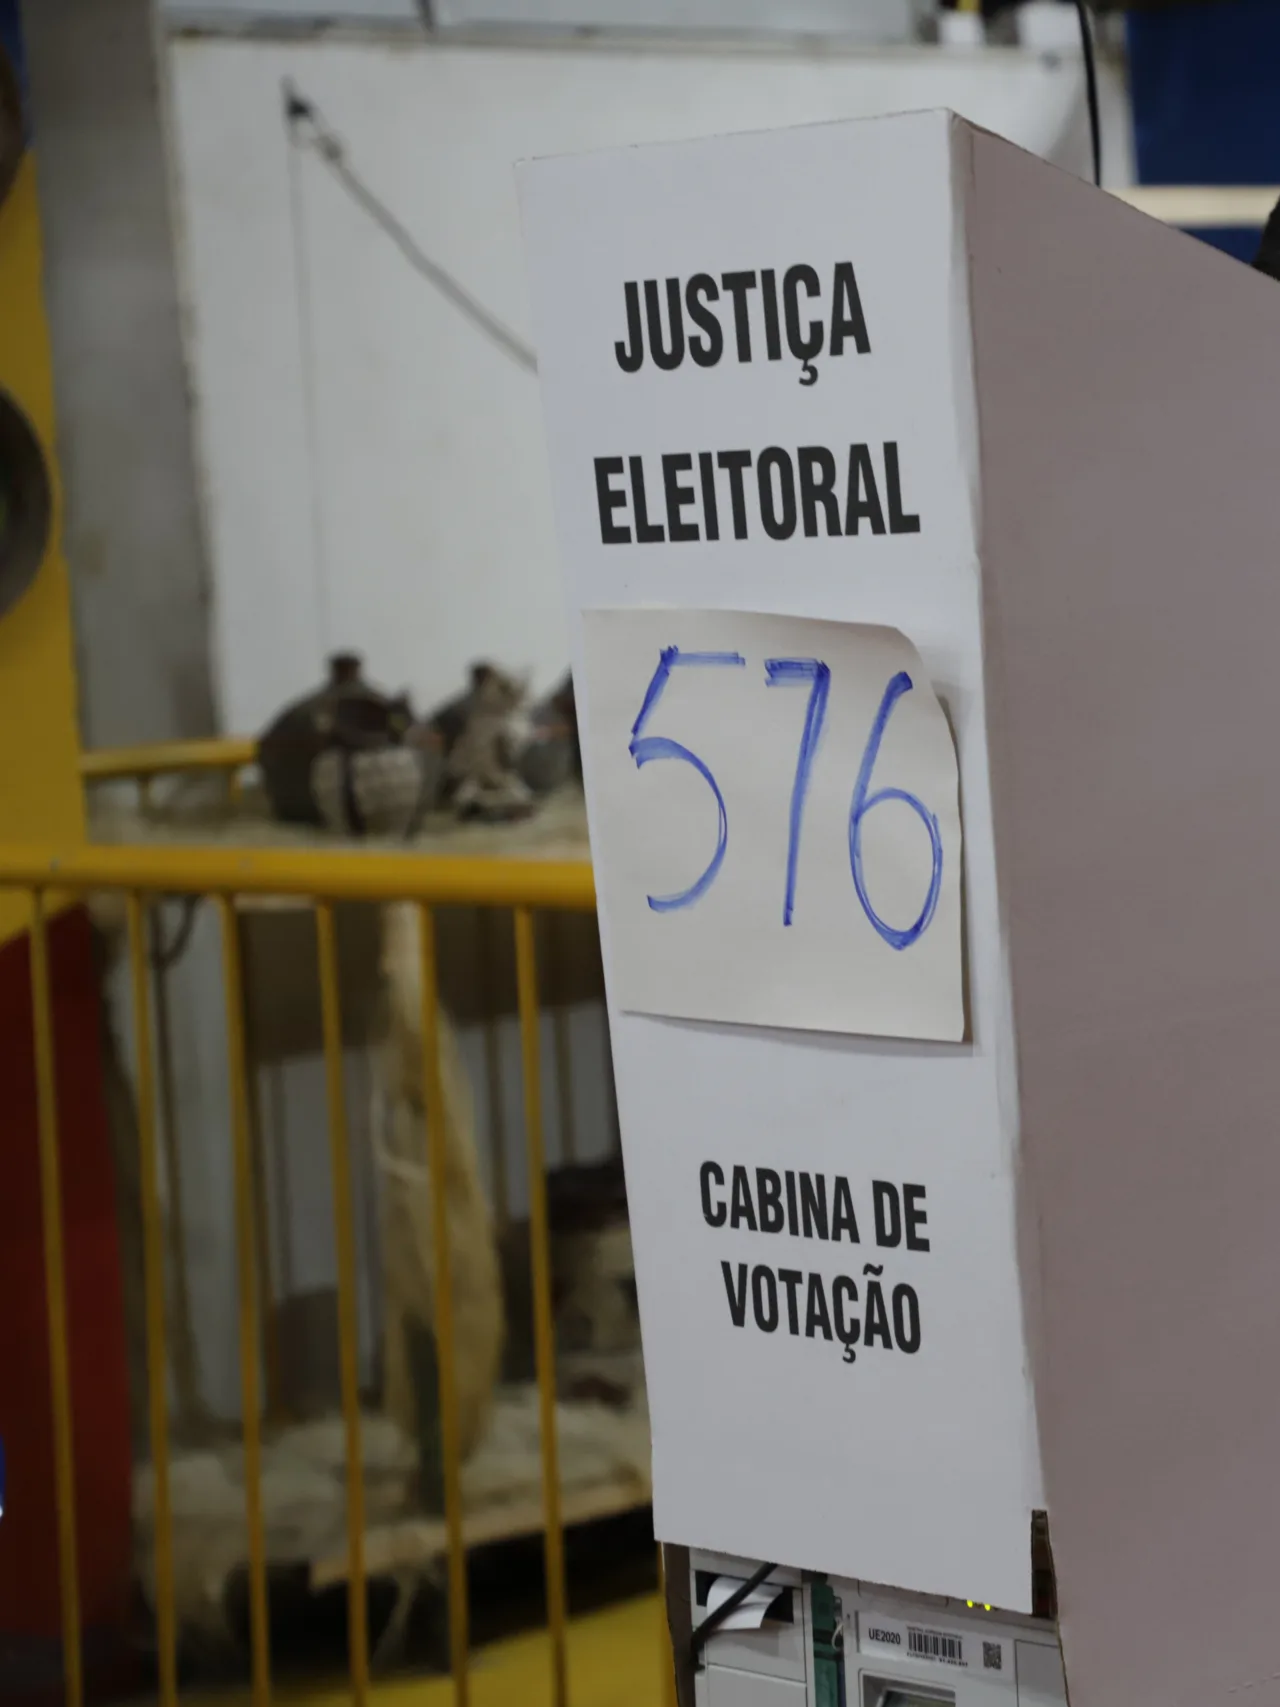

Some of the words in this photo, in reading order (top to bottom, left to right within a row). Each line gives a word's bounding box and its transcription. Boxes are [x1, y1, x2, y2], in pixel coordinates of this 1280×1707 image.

[614, 262, 871, 386] JUSTIÇA
[594, 441, 921, 545] ELEITORAL
[628, 645, 943, 951] 576
[700, 1161, 861, 1244] CABINA
[872, 1180, 931, 1252] DE
[720, 1260, 921, 1364] VOTAÇÃO
[868, 1627, 901, 1645] UE2020
